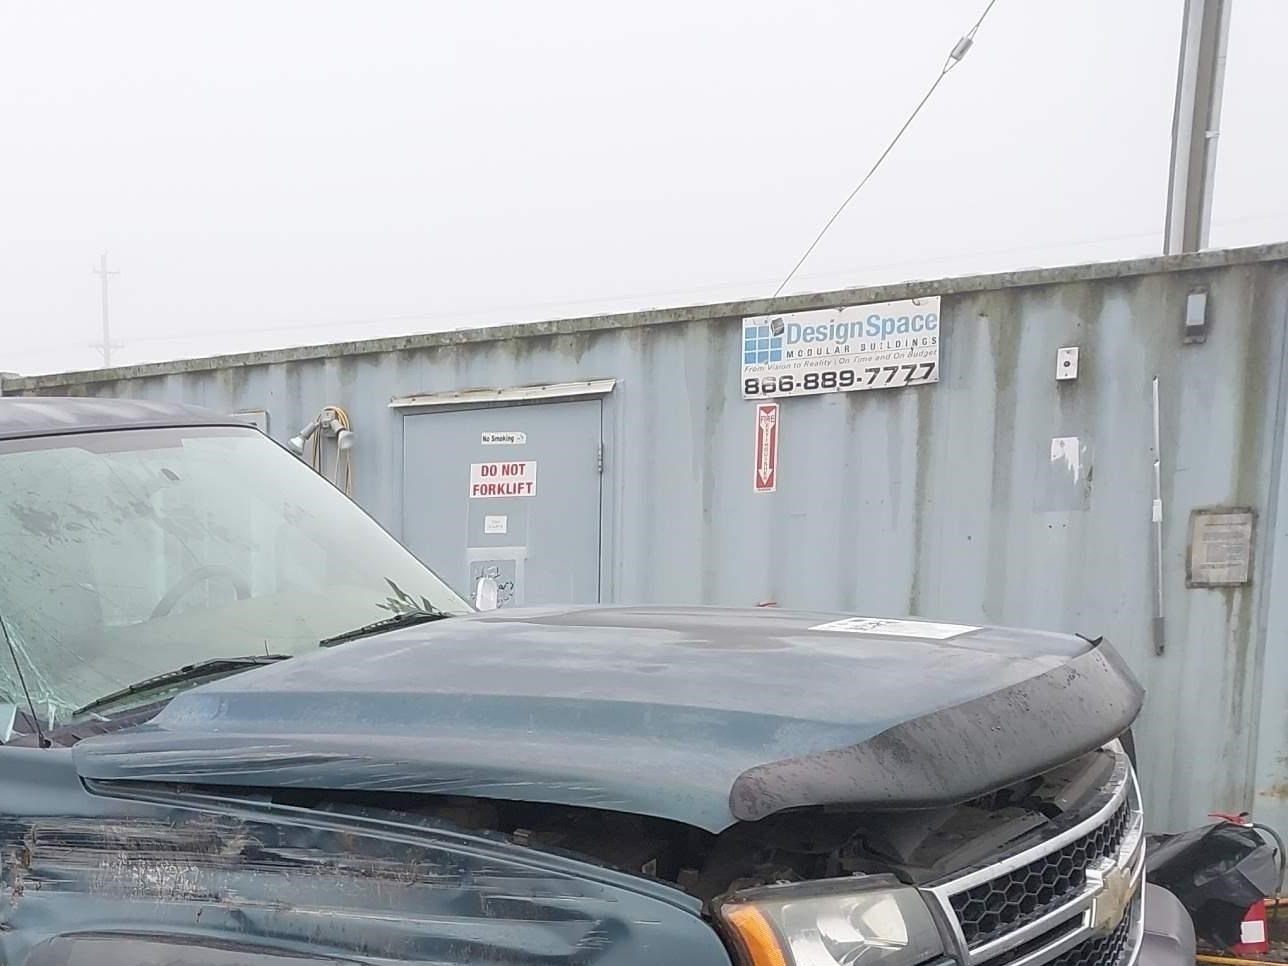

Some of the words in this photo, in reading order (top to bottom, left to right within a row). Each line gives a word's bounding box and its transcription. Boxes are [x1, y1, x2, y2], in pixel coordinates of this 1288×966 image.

[787, 313, 937, 344] DesignSpace
[786, 345, 850, 358] MODULAR
[860, 337, 937, 352] BUILDINGS
[803, 359, 832, 368] Reality
[875, 353, 891, 361] and
[907, 349, 937, 359] Budget
[744, 362, 935, 394] 866-889-7777
[760, 415, 776, 423] FIRE
[491, 435, 515, 443] Smoking
[481, 465, 497, 477] DO
[502, 463, 526, 476] NOT
[472, 482, 533, 496] FORKLIFT
